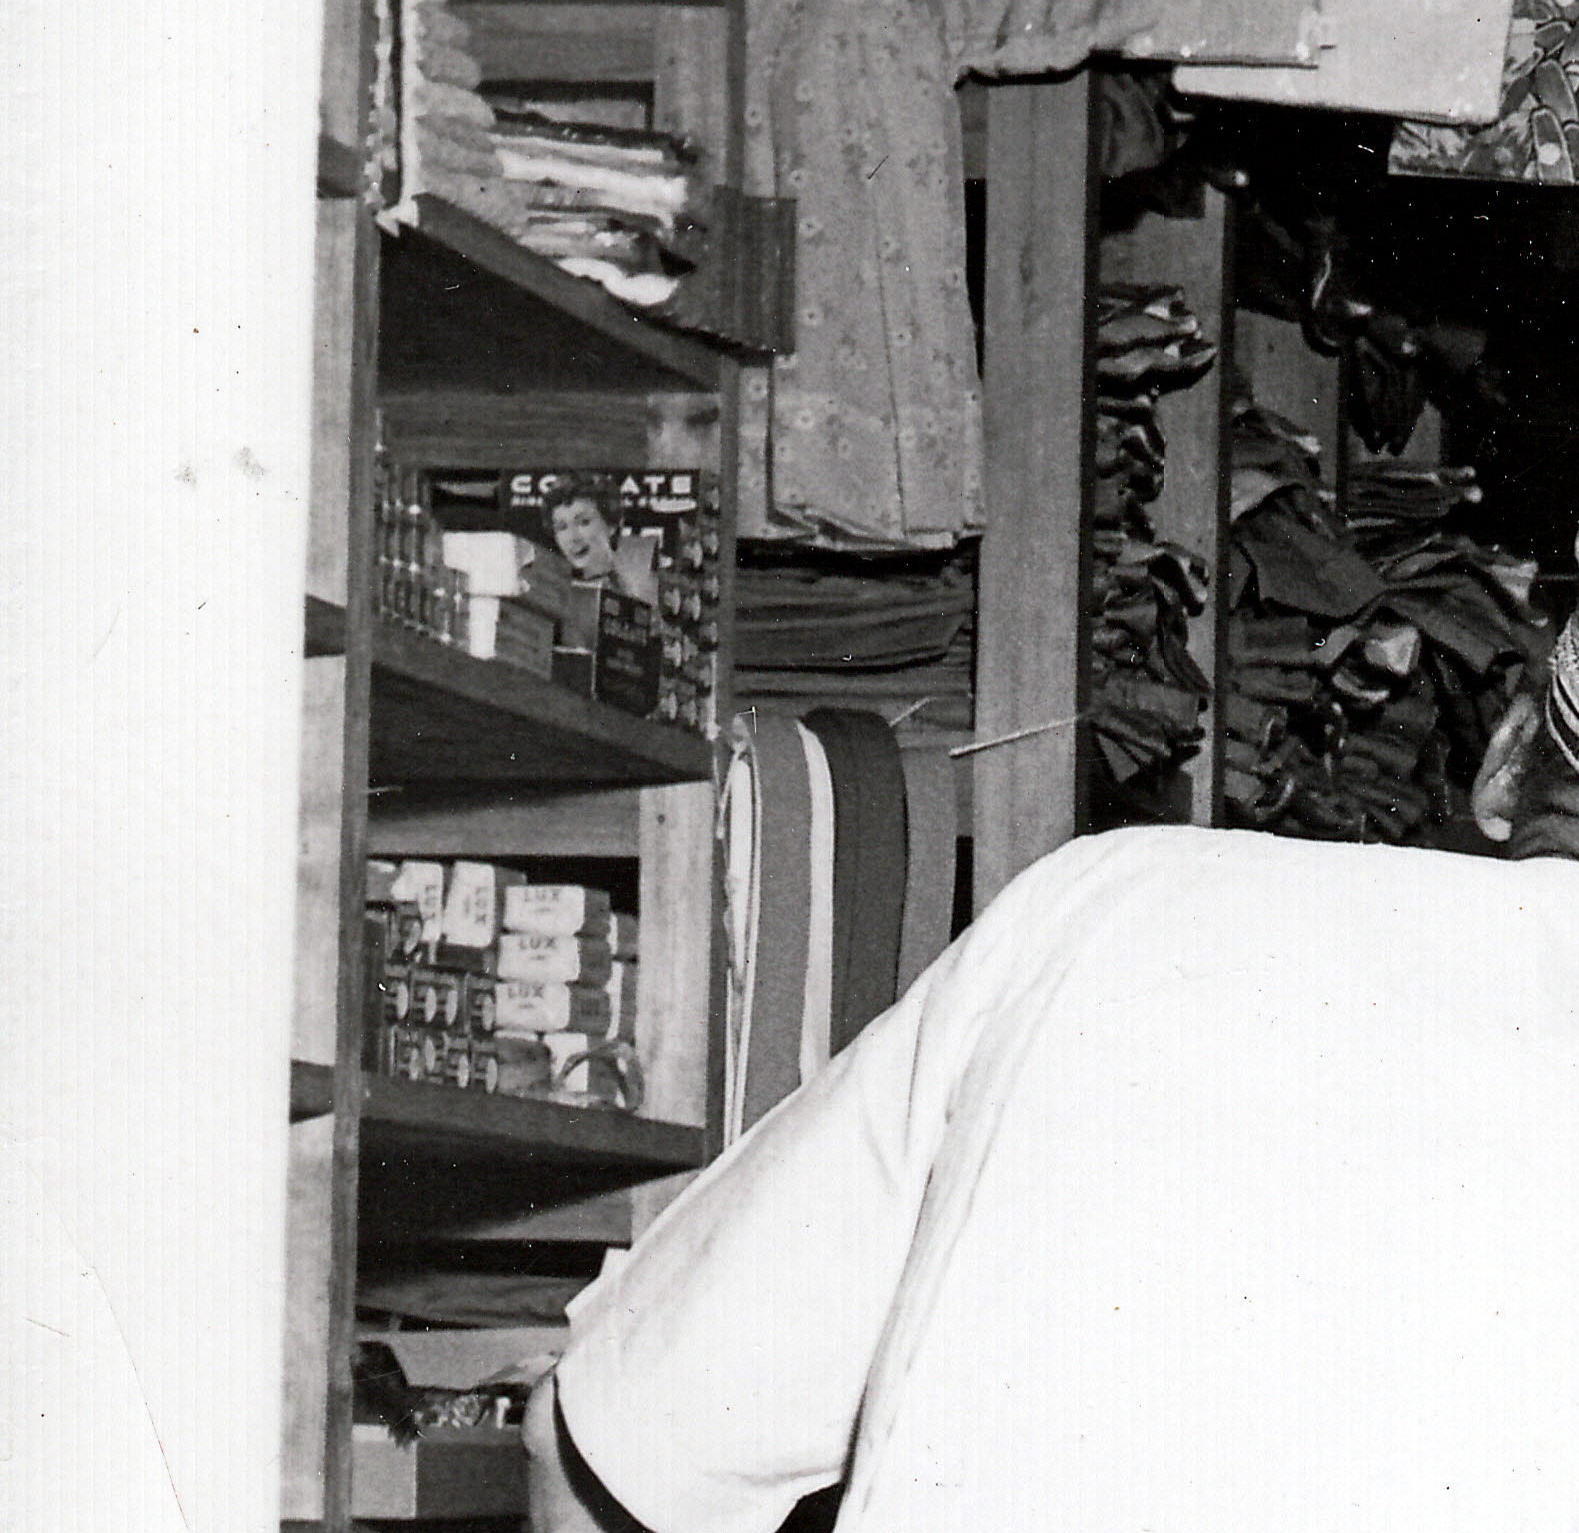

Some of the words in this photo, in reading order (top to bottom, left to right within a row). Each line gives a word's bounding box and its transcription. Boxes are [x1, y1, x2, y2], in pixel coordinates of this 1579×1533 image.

[510, 473, 692, 494] COATE
[524, 888, 562, 903] LUX
[519, 937, 558, 950] LUX
[507, 983, 544, 998] LUX
